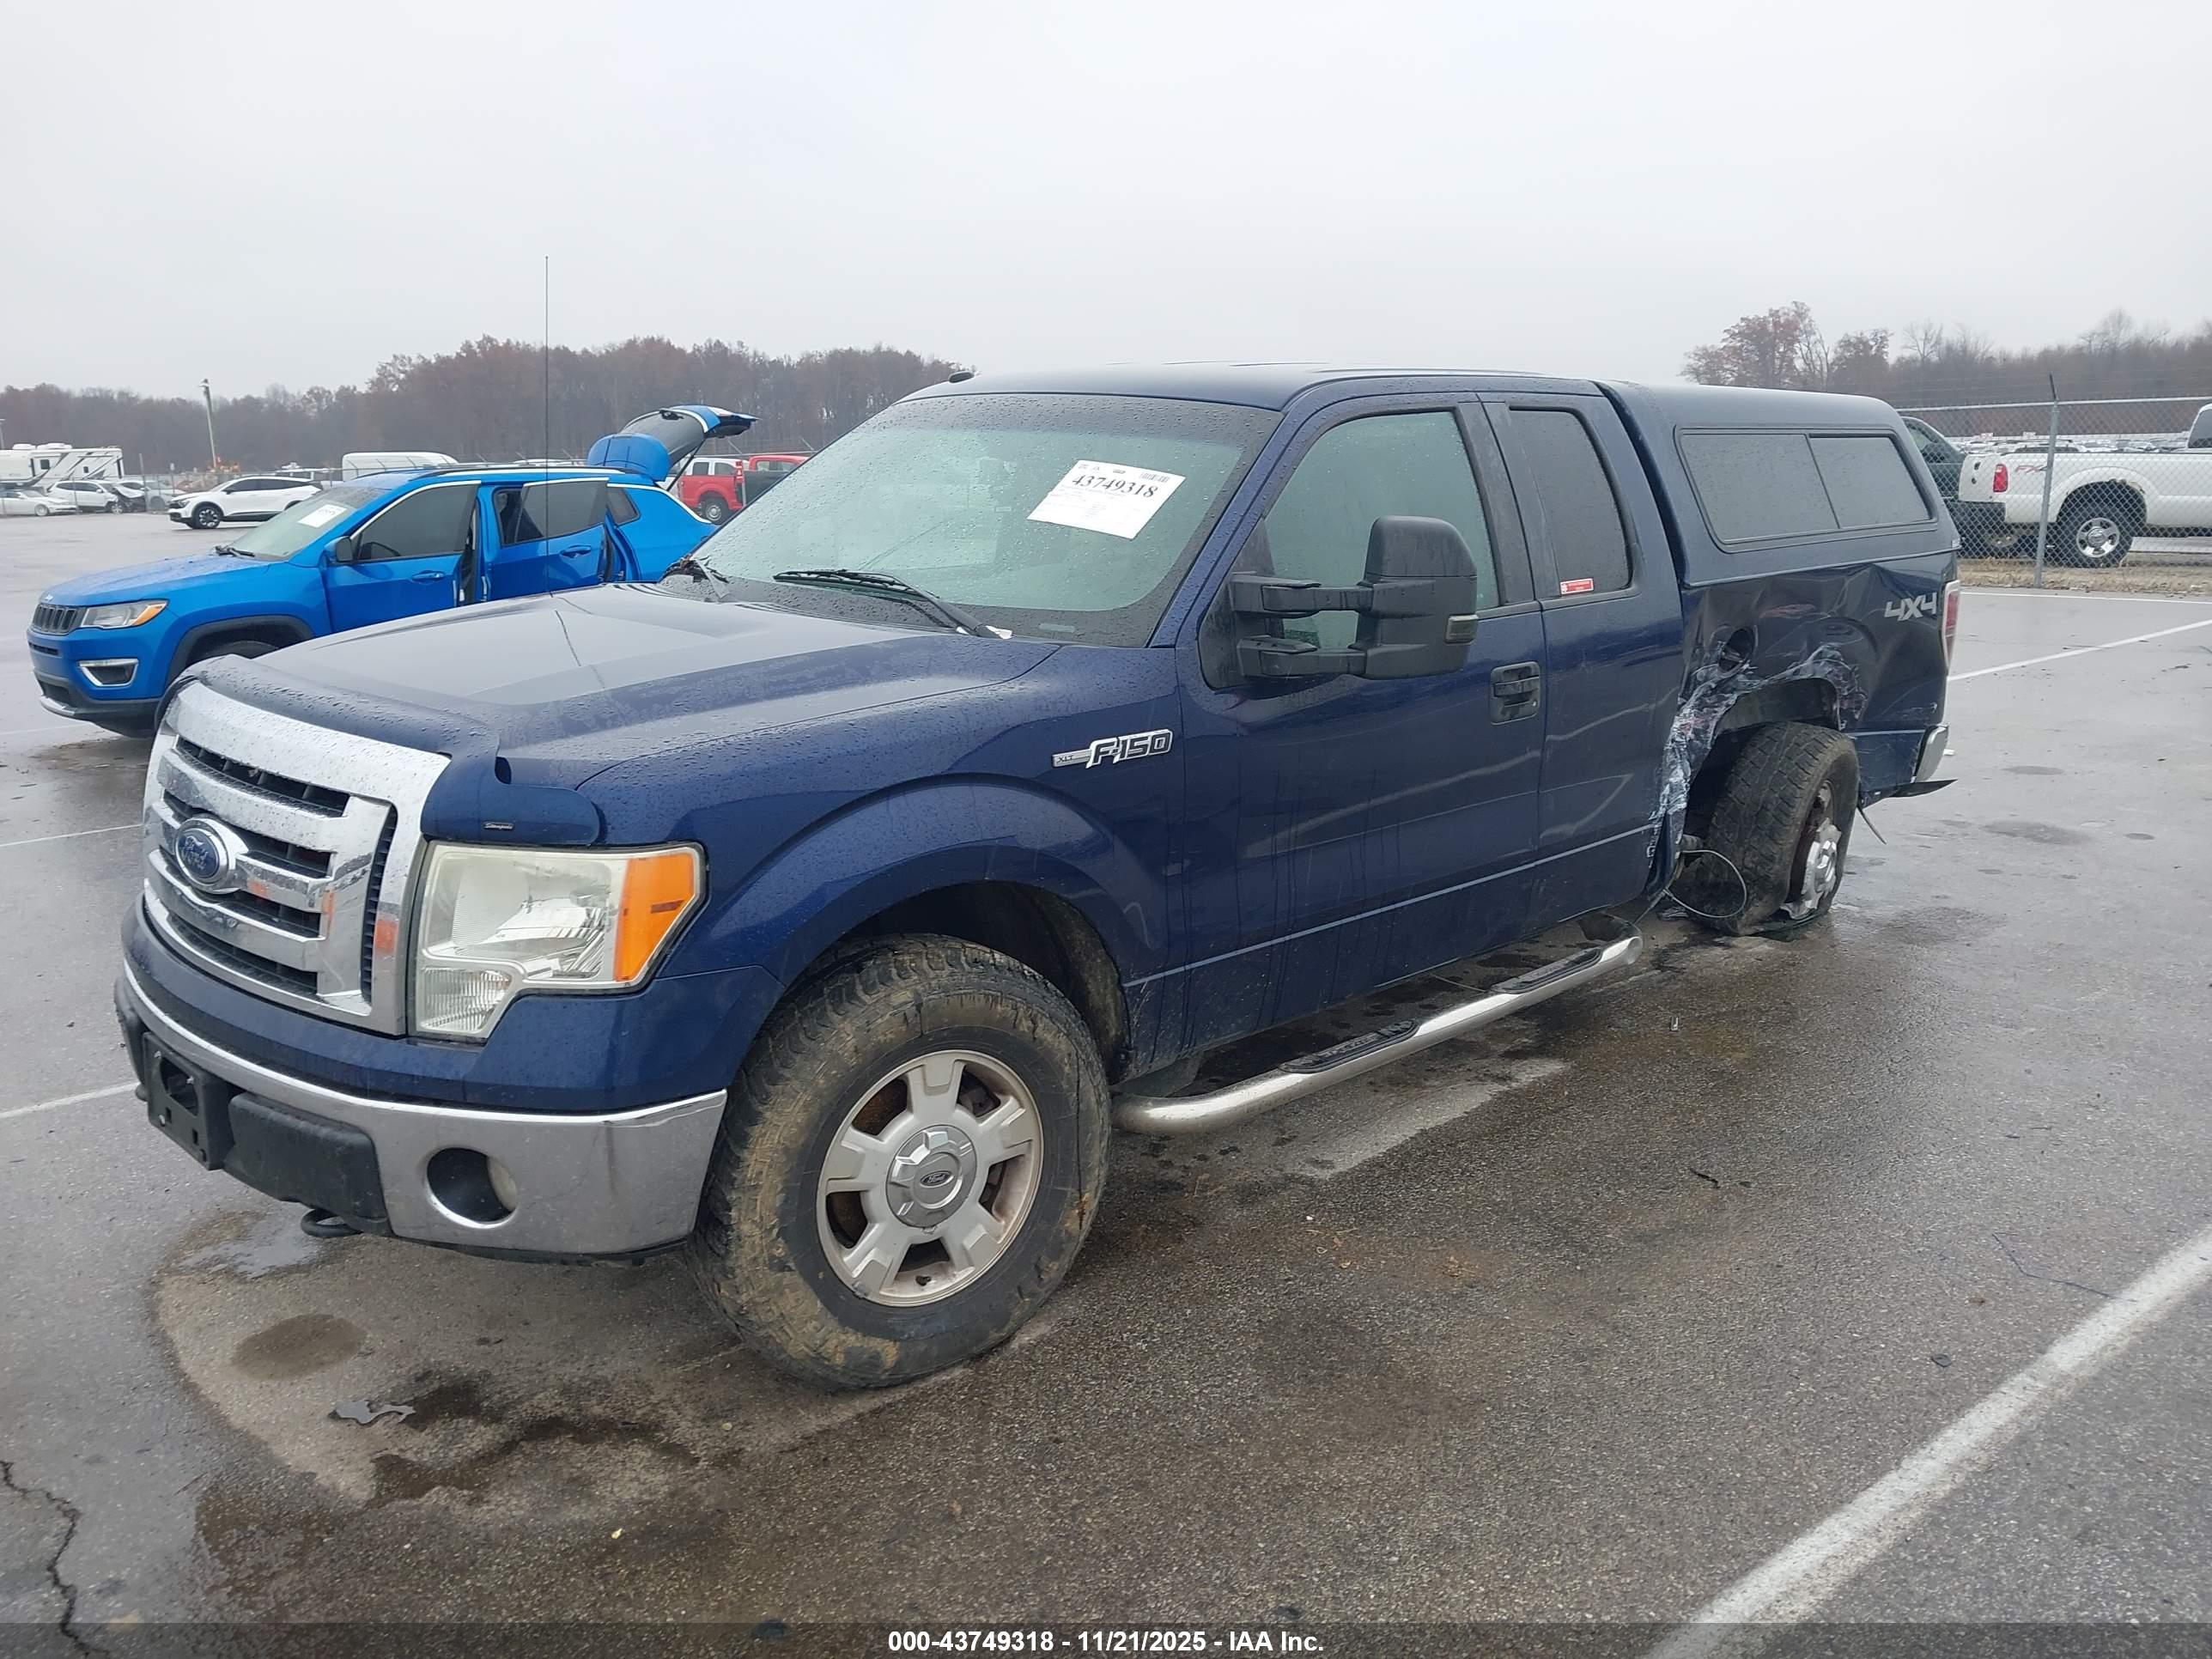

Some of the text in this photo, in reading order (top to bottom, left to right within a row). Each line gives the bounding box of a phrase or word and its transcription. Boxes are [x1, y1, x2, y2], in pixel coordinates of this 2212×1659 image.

[1072, 474, 1158, 498] 43749318
[1056, 754, 1074, 764] XLT
[181, 836, 208, 871] Ford
